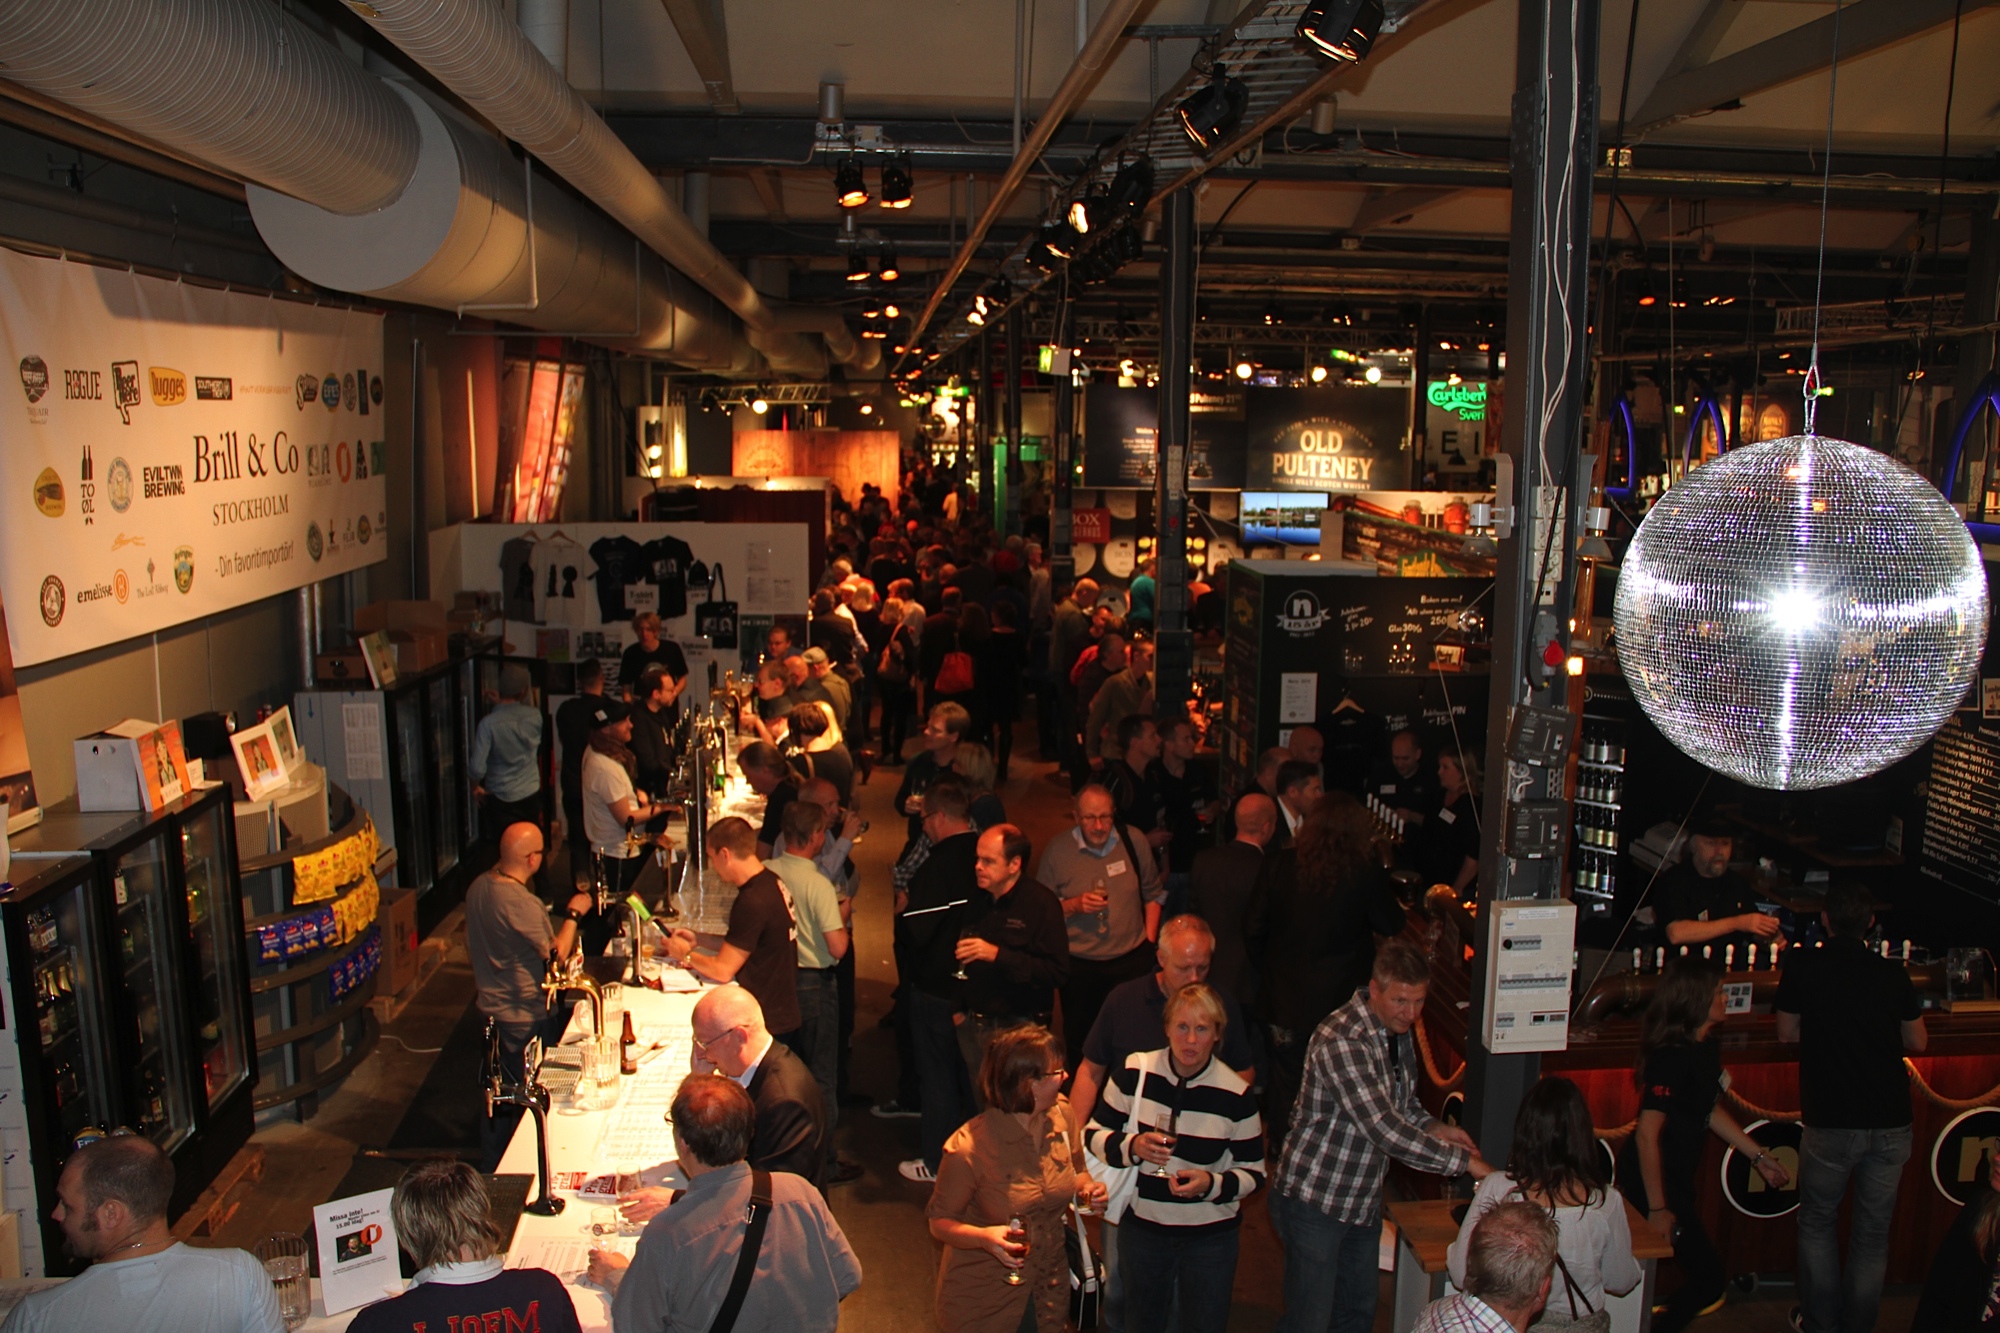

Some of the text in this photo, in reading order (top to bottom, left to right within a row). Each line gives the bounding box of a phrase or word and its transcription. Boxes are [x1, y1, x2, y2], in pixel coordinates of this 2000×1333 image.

[64, 370, 102, 400] ROGUE
[151, 371, 185, 401] Dugges
[323, 383, 340, 399] EFES
[1427, 381, 1487, 407] Carlsber
[1459, 409, 1485, 421] Sveri
[1300, 429, 1344, 454] OLD
[1311, 416, 1330, 424] WICK
[1338, 421, 1374, 449] SCOTLAND
[193, 430, 299, 483] Brill & Co
[1272, 453, 1374, 481] PULTENEY
[81, 483, 95, 498] TO
[144, 480, 186, 499] BREWING
[1294, 478, 1314, 487] MALT
[1315, 479, 1342, 489] SCOTCH
[1342, 481, 1371, 490] WHISKY
[212, 494, 290, 527] STOCKHOLM
[219, 554, 233, 578] Din
[234, 540, 294, 574] favoritimportör!
[77, 583, 114, 604] emelisse
[630, 590, 654, 599] T-shirt
[1452, 705, 1467, 716] PIN
[329, 1213, 348, 1223] Missa
[348, 1207, 364, 1217] inte!
